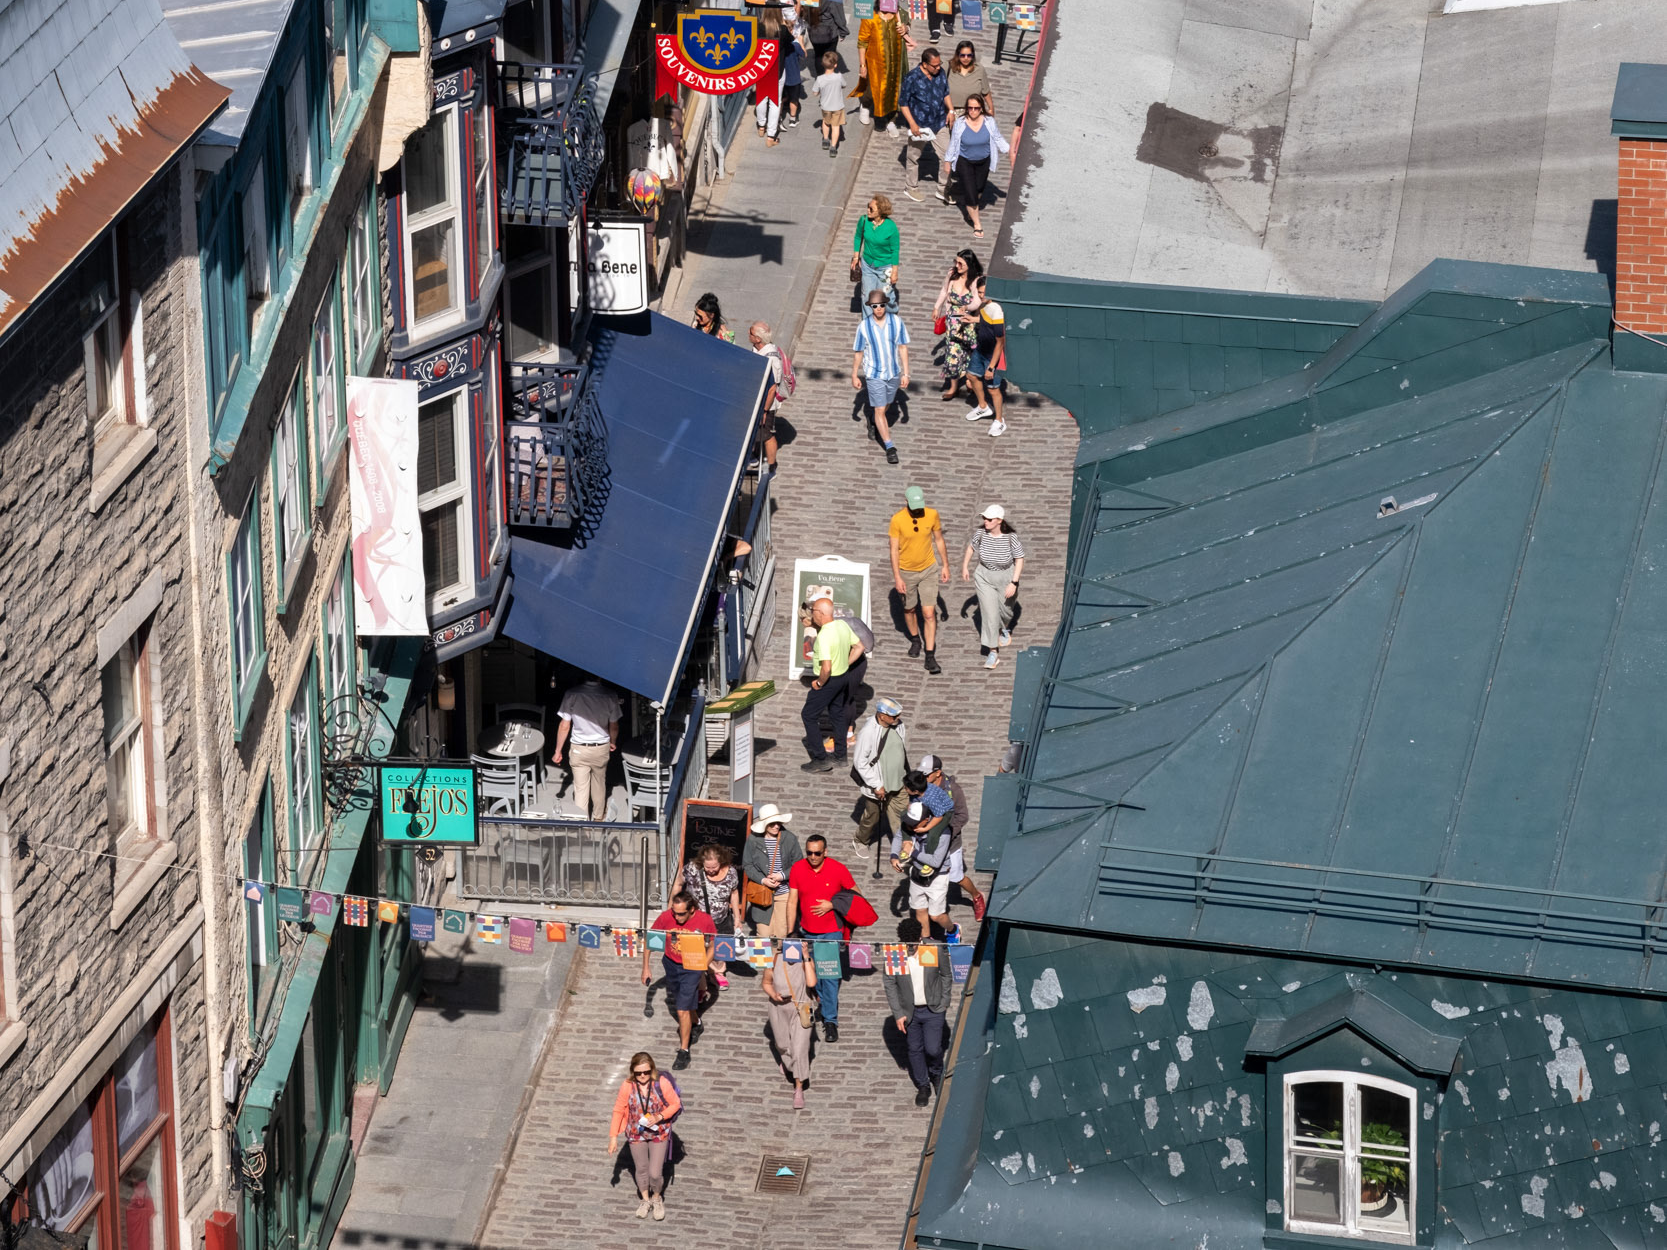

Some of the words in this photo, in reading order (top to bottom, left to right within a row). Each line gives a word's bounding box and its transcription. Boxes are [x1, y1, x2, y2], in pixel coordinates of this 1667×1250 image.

[657, 38, 736, 91] SOUVENIRS
[738, 68, 758, 86] DU
[753, 41, 776, 73] LYS
[601, 260, 638, 274] Bene
[373, 490, 387, 514] 2008
[387, 774, 468, 784] COLLECTIONS
[425, 848, 436, 861] 52
